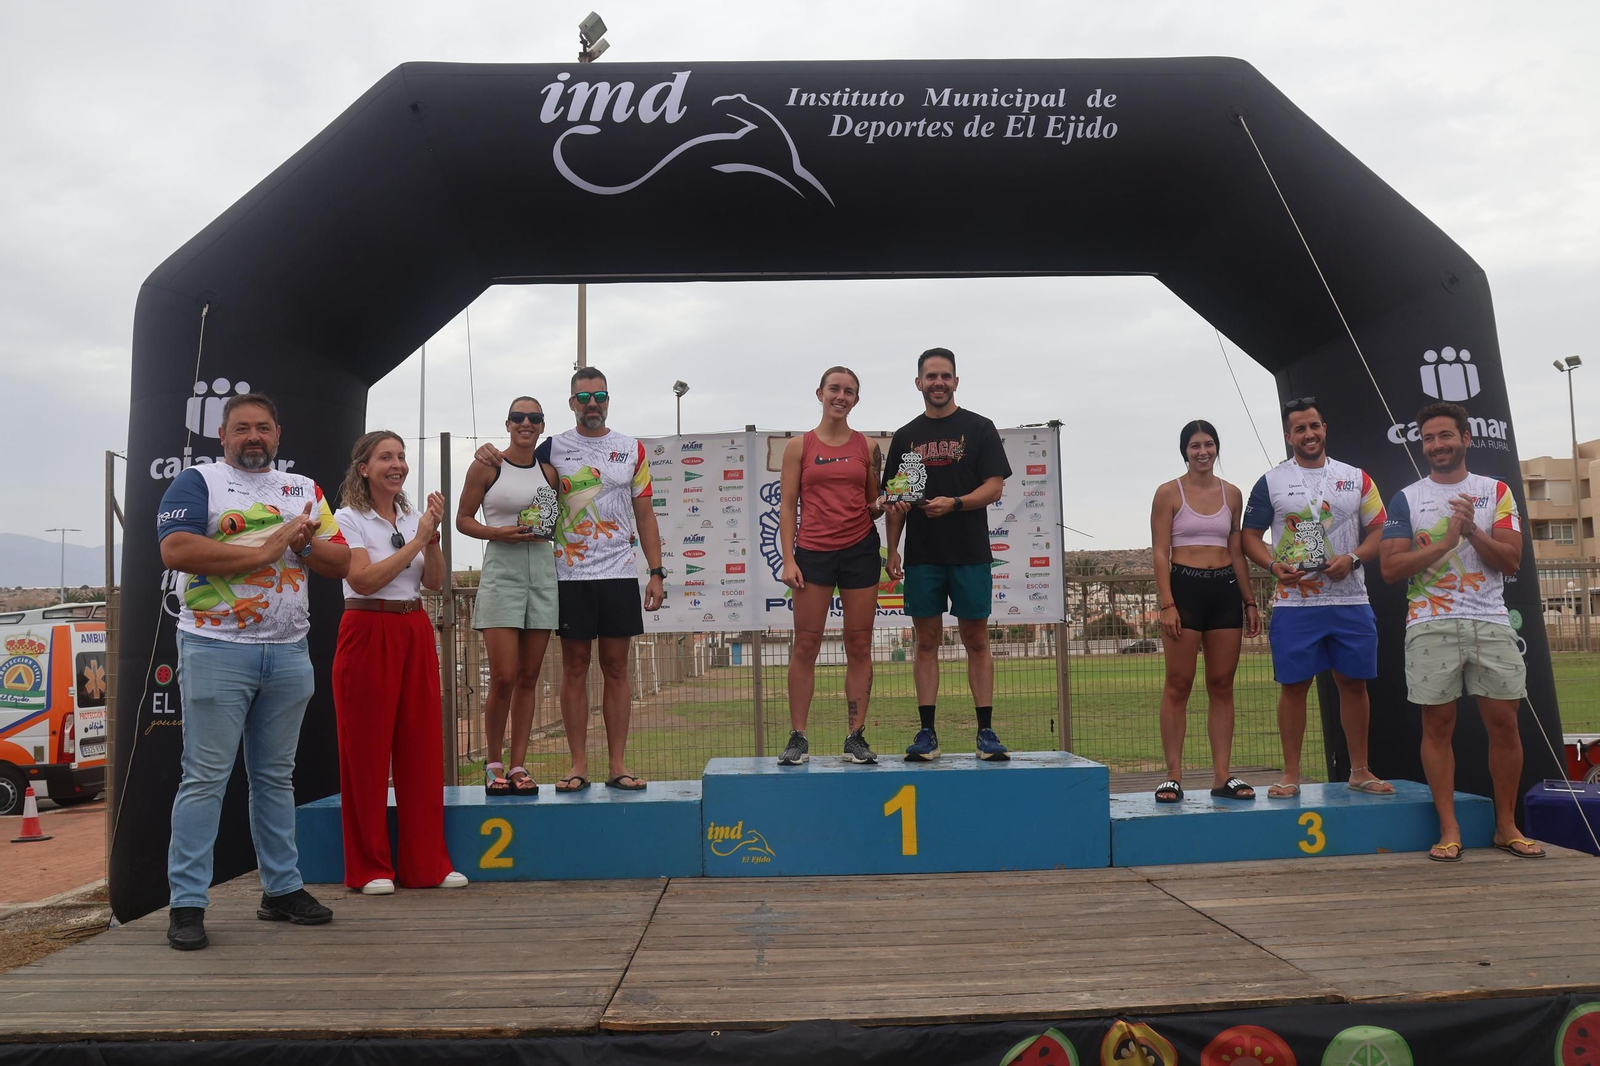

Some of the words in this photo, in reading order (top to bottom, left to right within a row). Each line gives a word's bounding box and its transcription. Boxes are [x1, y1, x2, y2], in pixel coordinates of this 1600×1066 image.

[539, 70, 692, 124] imd
[785, 87, 905, 109] Instituto
[923, 87, 1067, 113] Municipal
[1086, 88, 1118, 109] de
[828, 114, 954, 144] Deportes
[963, 116, 996, 139] de
[1003, 115, 1036, 139] El
[1043, 114, 1119, 145] Ejido
[1387, 417, 1508, 444] camar
[1469, 439, 1487, 449] AJA
[1181, 568, 1212, 578] NIKE
[1214, 567, 1234, 578] PRO
[152, 692, 175, 714] EL
[707, 820, 743, 840] imd
[883, 785, 917, 856] 1
[1298, 811, 1326, 854] 3
[479, 818, 514, 869] 2
[751, 855, 771, 865] Ejido
